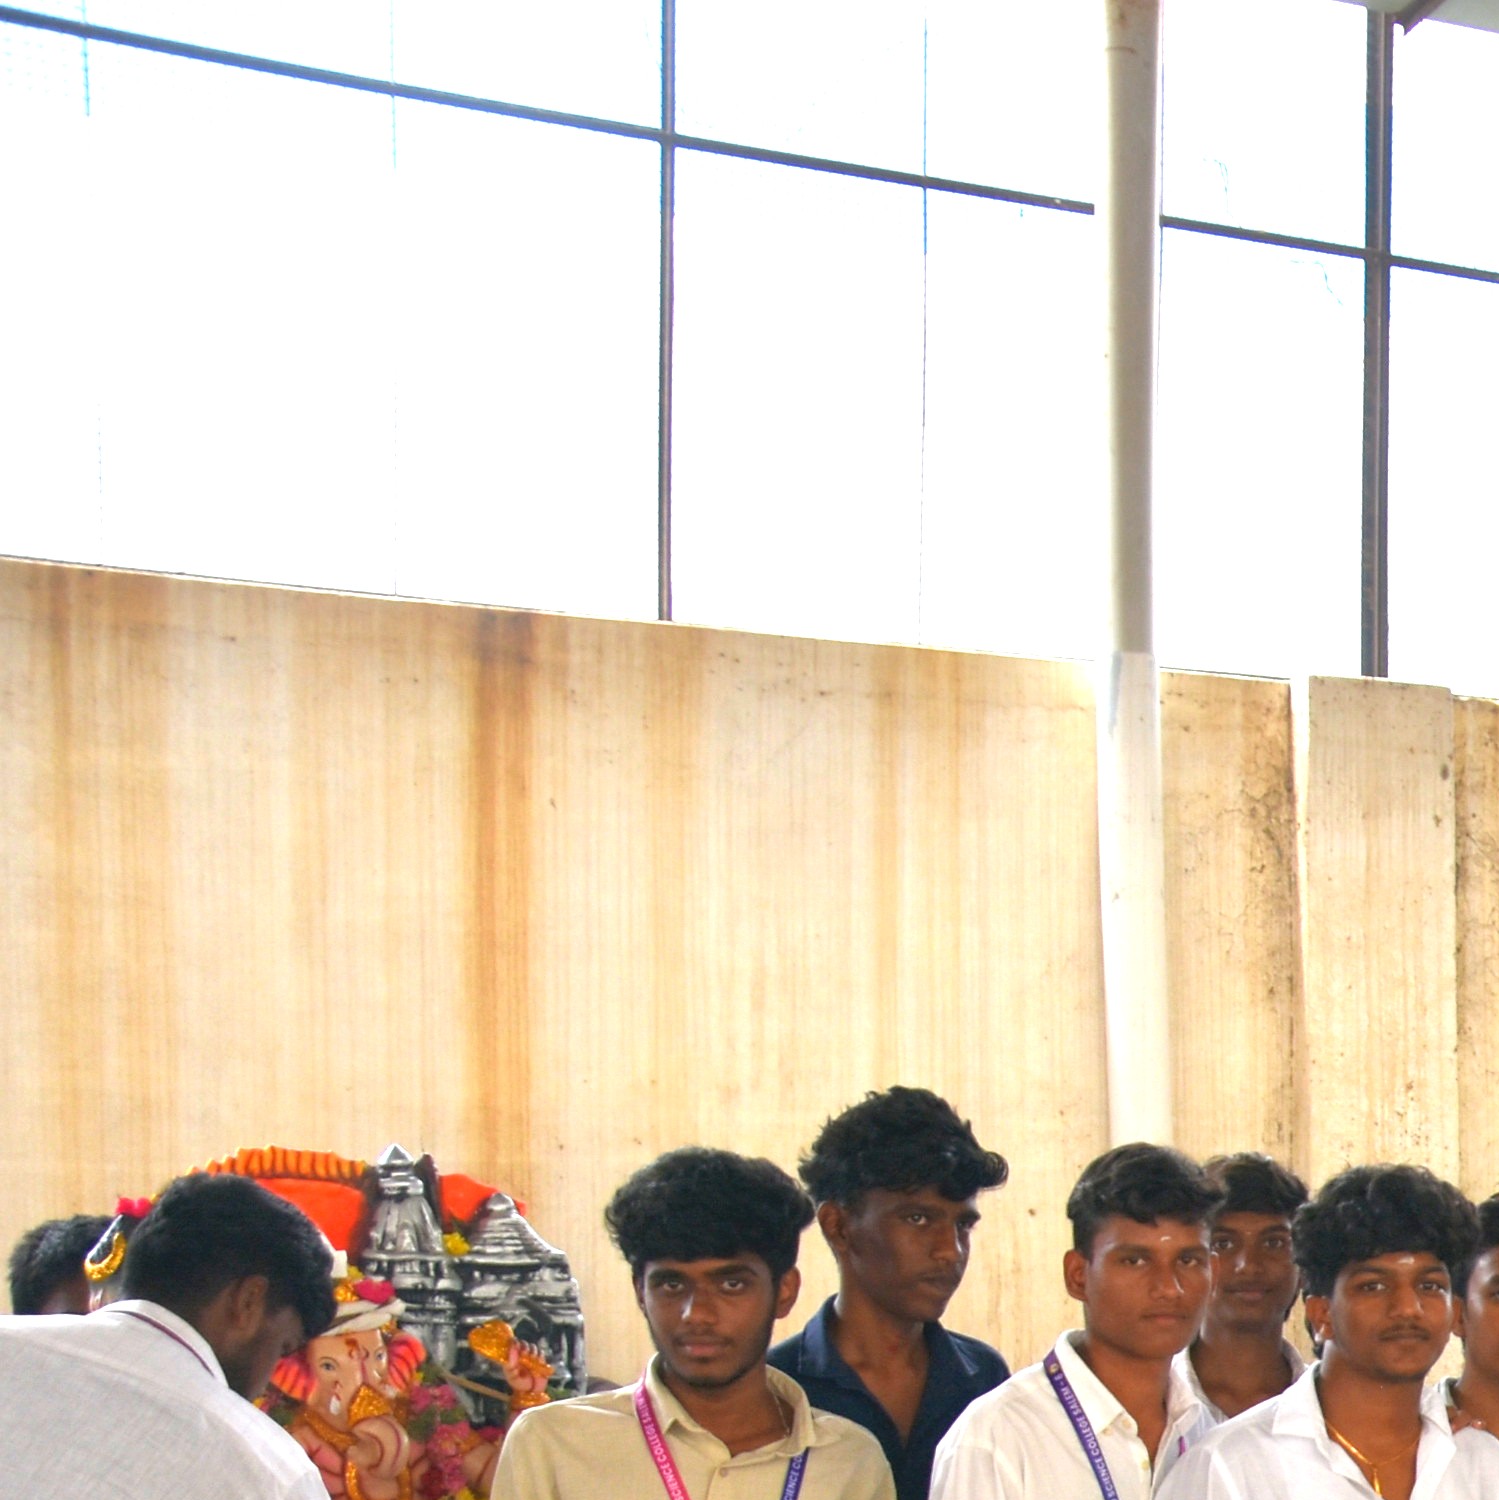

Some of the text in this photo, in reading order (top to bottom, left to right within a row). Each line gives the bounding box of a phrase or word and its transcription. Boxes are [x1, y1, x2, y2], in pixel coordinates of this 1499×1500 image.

[1061, 1386, 1081, 1416] SALEM
[645, 1422, 668, 1462] COLLEGE
[1076, 1416, 1100, 1456] COLLEGE
[1095, 1456, 1116, 1498] SCIENCE
